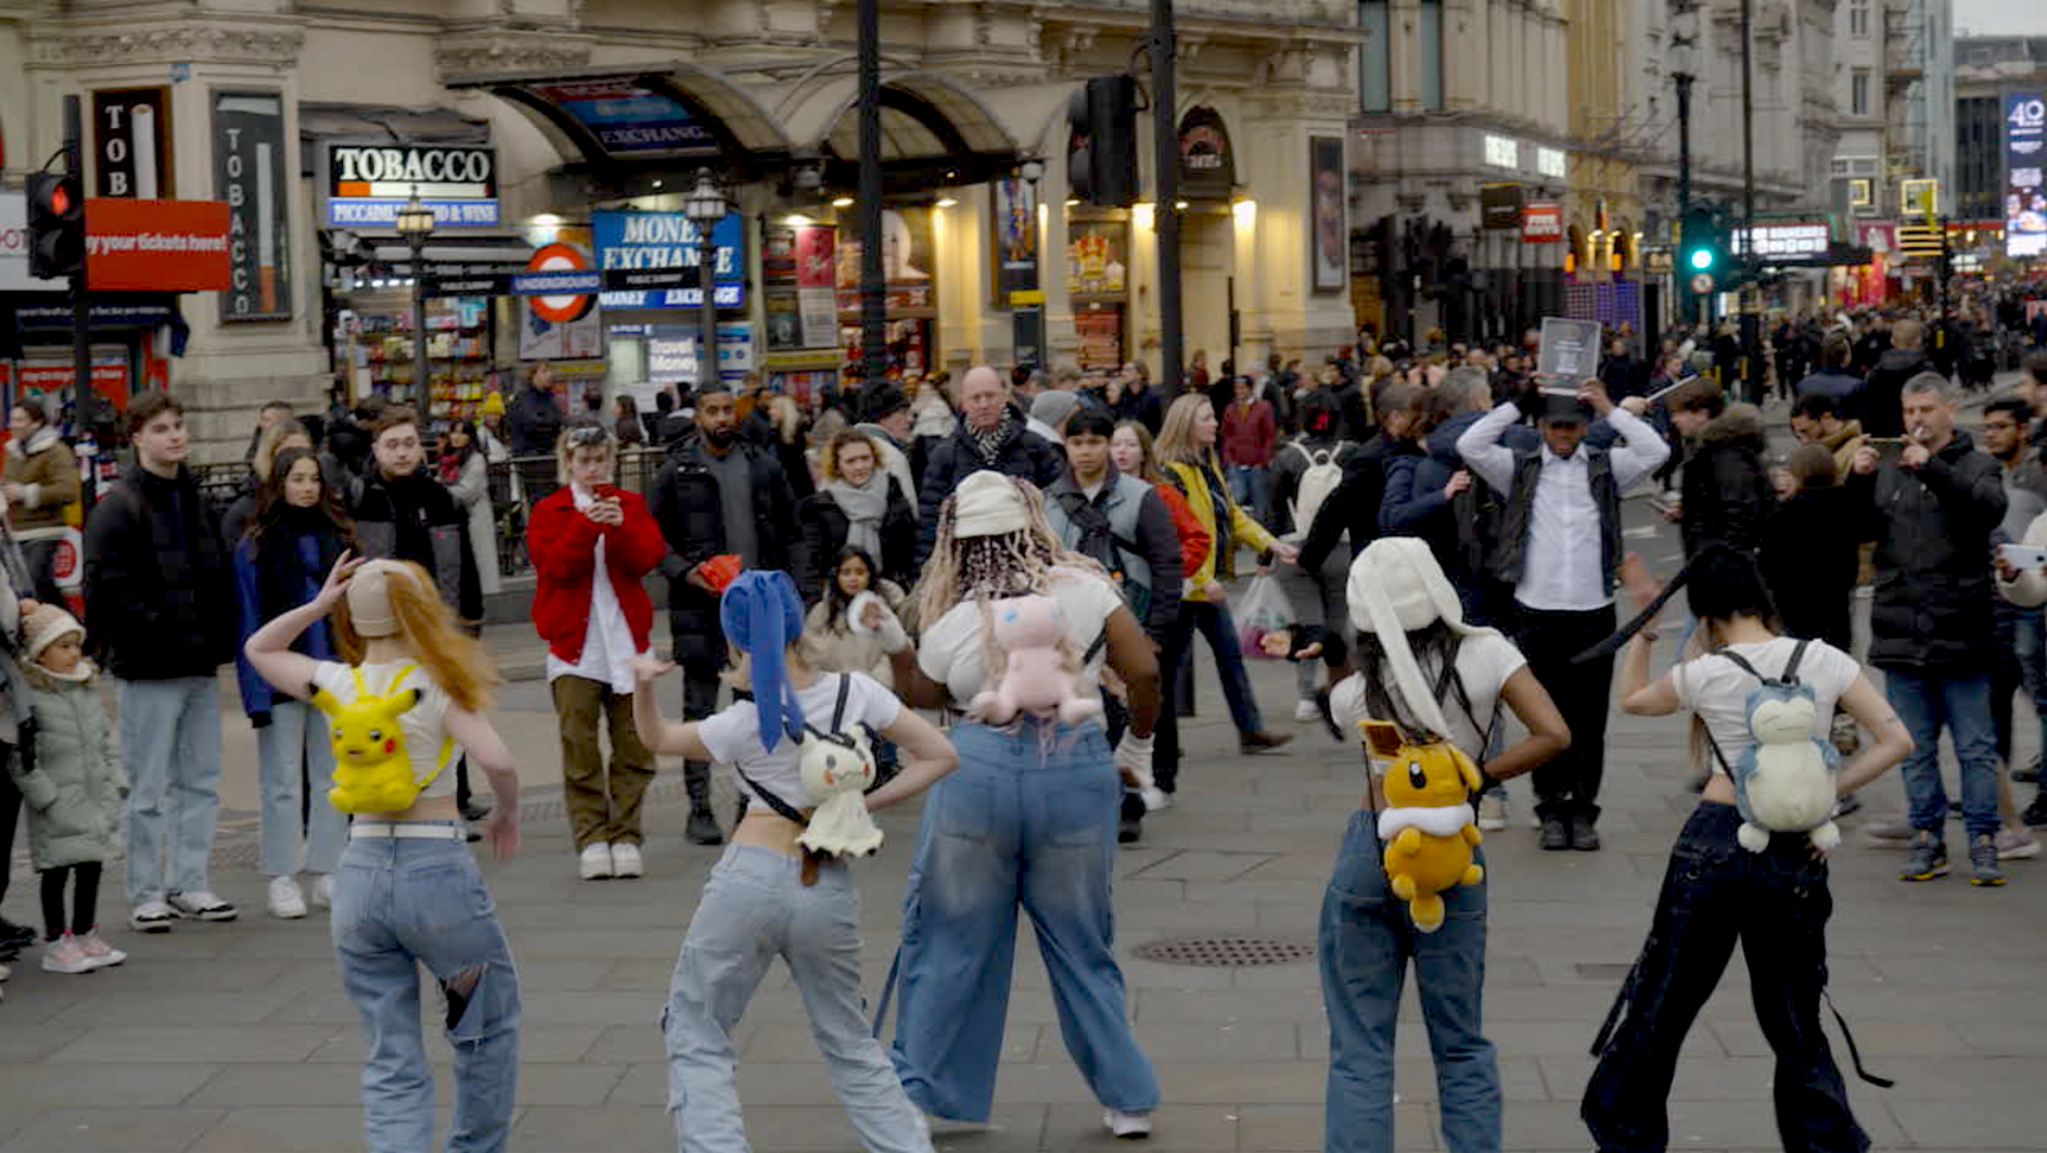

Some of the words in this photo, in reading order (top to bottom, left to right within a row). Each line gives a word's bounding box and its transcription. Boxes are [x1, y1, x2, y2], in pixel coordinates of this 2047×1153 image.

[601, 125, 714, 143] EXCHANG
[336, 148, 490, 181] TOBACCO
[226, 128, 250, 315] TOBACCO
[622, 216, 703, 243] MONE
[101, 236, 136, 256] your
[138, 233, 187, 251] tickets
[603, 246, 734, 273] EXCHANE
[514, 276, 600, 291] UNDERGROUND
